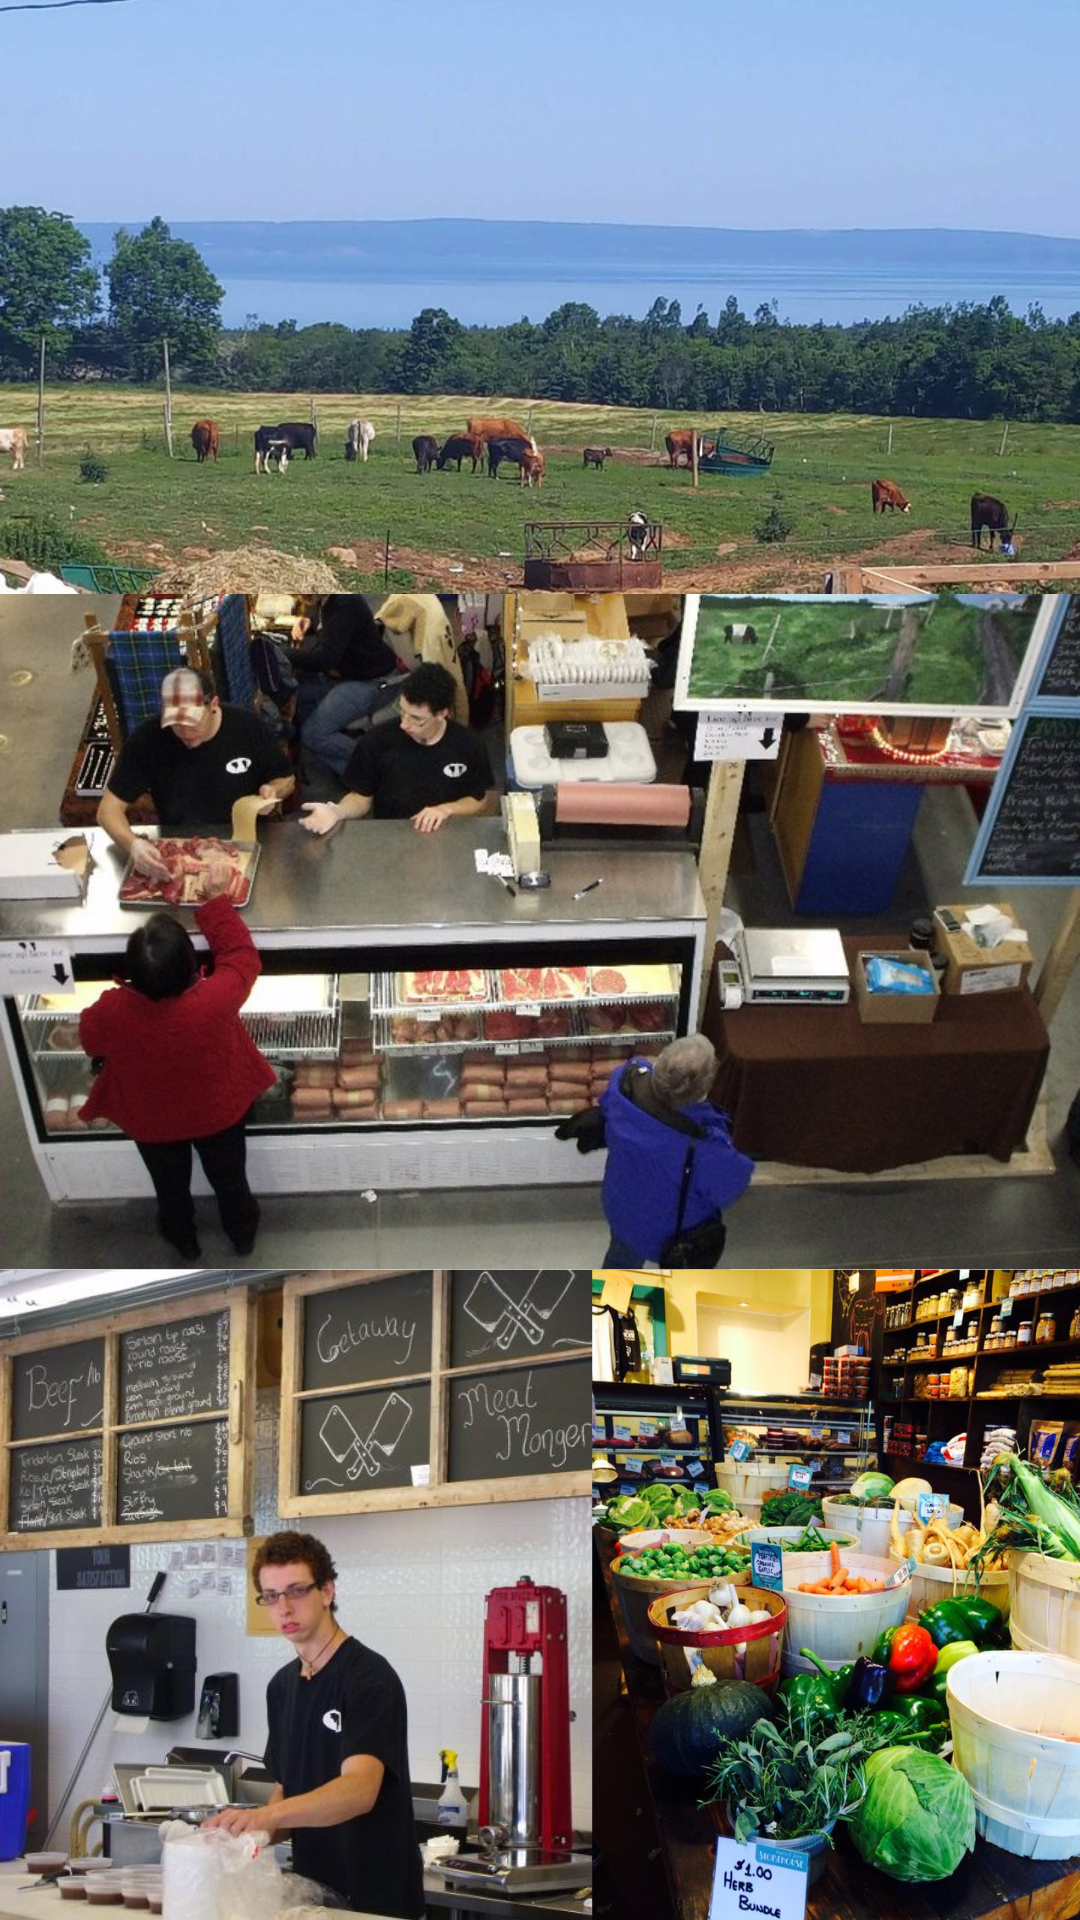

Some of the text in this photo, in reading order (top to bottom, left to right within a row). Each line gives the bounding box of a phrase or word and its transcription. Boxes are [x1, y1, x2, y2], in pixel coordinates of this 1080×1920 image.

[316, 1313, 417, 1365] Getaway
[26, 1364, 83, 1426] Beef
[458, 1370, 538, 1428] Meat
[495, 1413, 592, 1468] Monger
[734, 1859, 772, 1880] $1.00
[759, 1850, 804, 1869] STOREHOUSE
